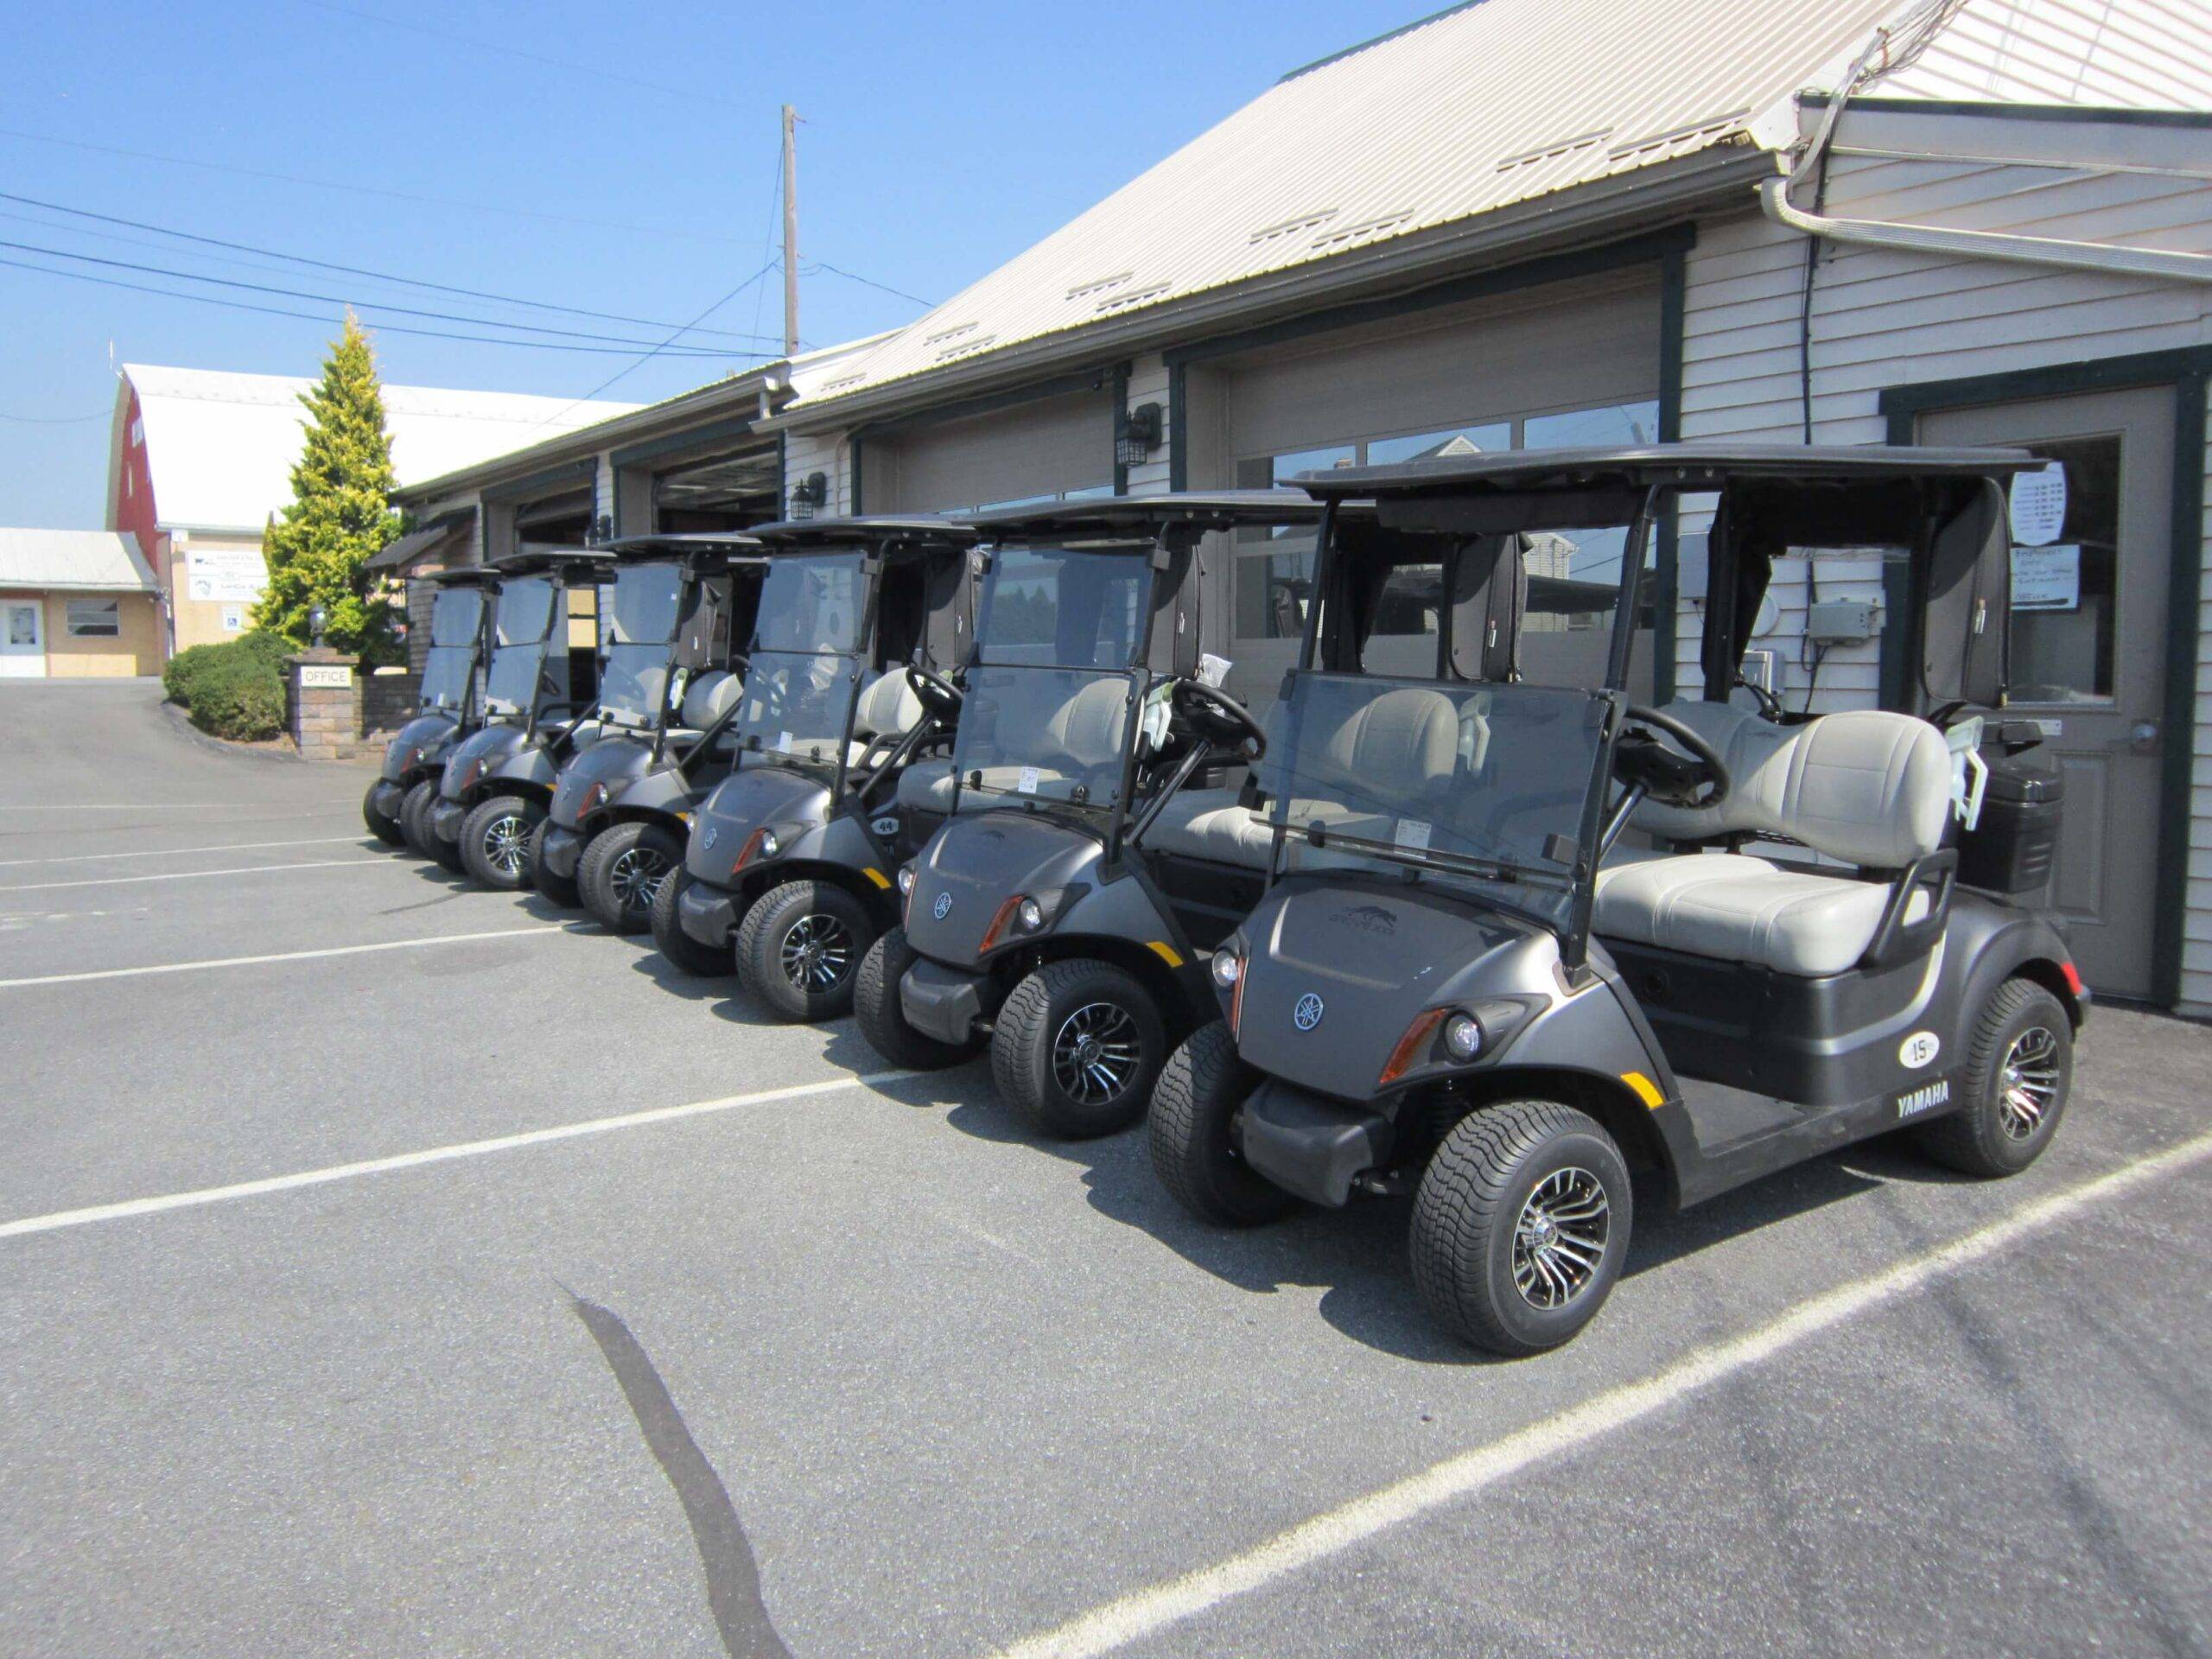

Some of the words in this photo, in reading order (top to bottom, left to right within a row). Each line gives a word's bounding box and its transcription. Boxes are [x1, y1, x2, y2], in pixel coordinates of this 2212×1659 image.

[305, 671, 346, 682] OFFICE
[1913, 1039, 1927, 1061] 15
[1897, 1080, 1948, 1118] YAMAHA
